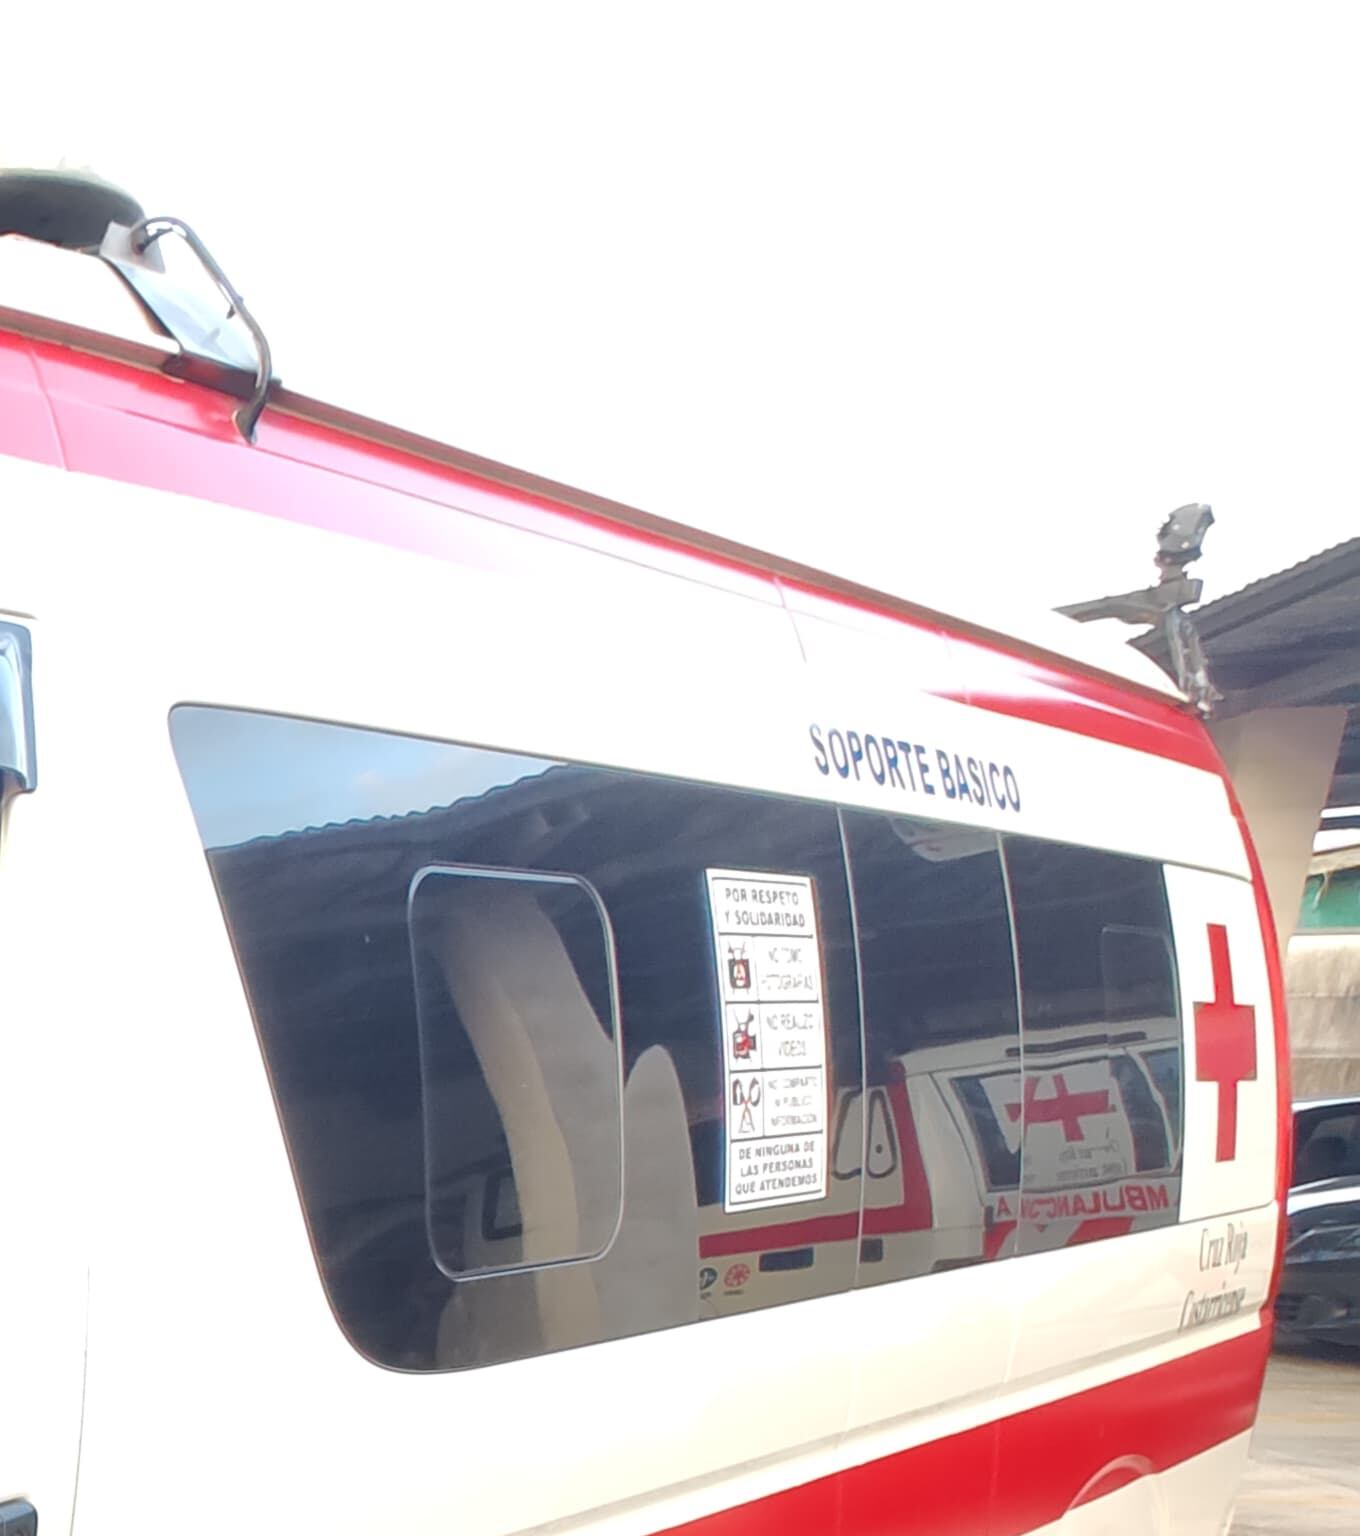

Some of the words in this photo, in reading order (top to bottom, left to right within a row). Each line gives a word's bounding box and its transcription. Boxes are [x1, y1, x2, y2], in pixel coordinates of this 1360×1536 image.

[808, 723, 935, 795] SOPORTE
[936, 749, 1021, 813] BASICO
[725, 887, 748, 902] POR
[751, 888, 799, 906] RESPETO
[725, 909, 730, 924] Y
[735, 909, 805, 928] SOLIDARIDAD
[739, 1147, 751, 1160] DE
[755, 1143, 800, 1157] NINGUNA
[803, 1140, 815, 1152] DE
[740, 1164, 759, 1177] LAS
[762, 1157, 813, 1174] PERSONAS
[735, 1181, 755, 1194] QUE
[760, 1173, 817, 1191] ATENDEMOS
